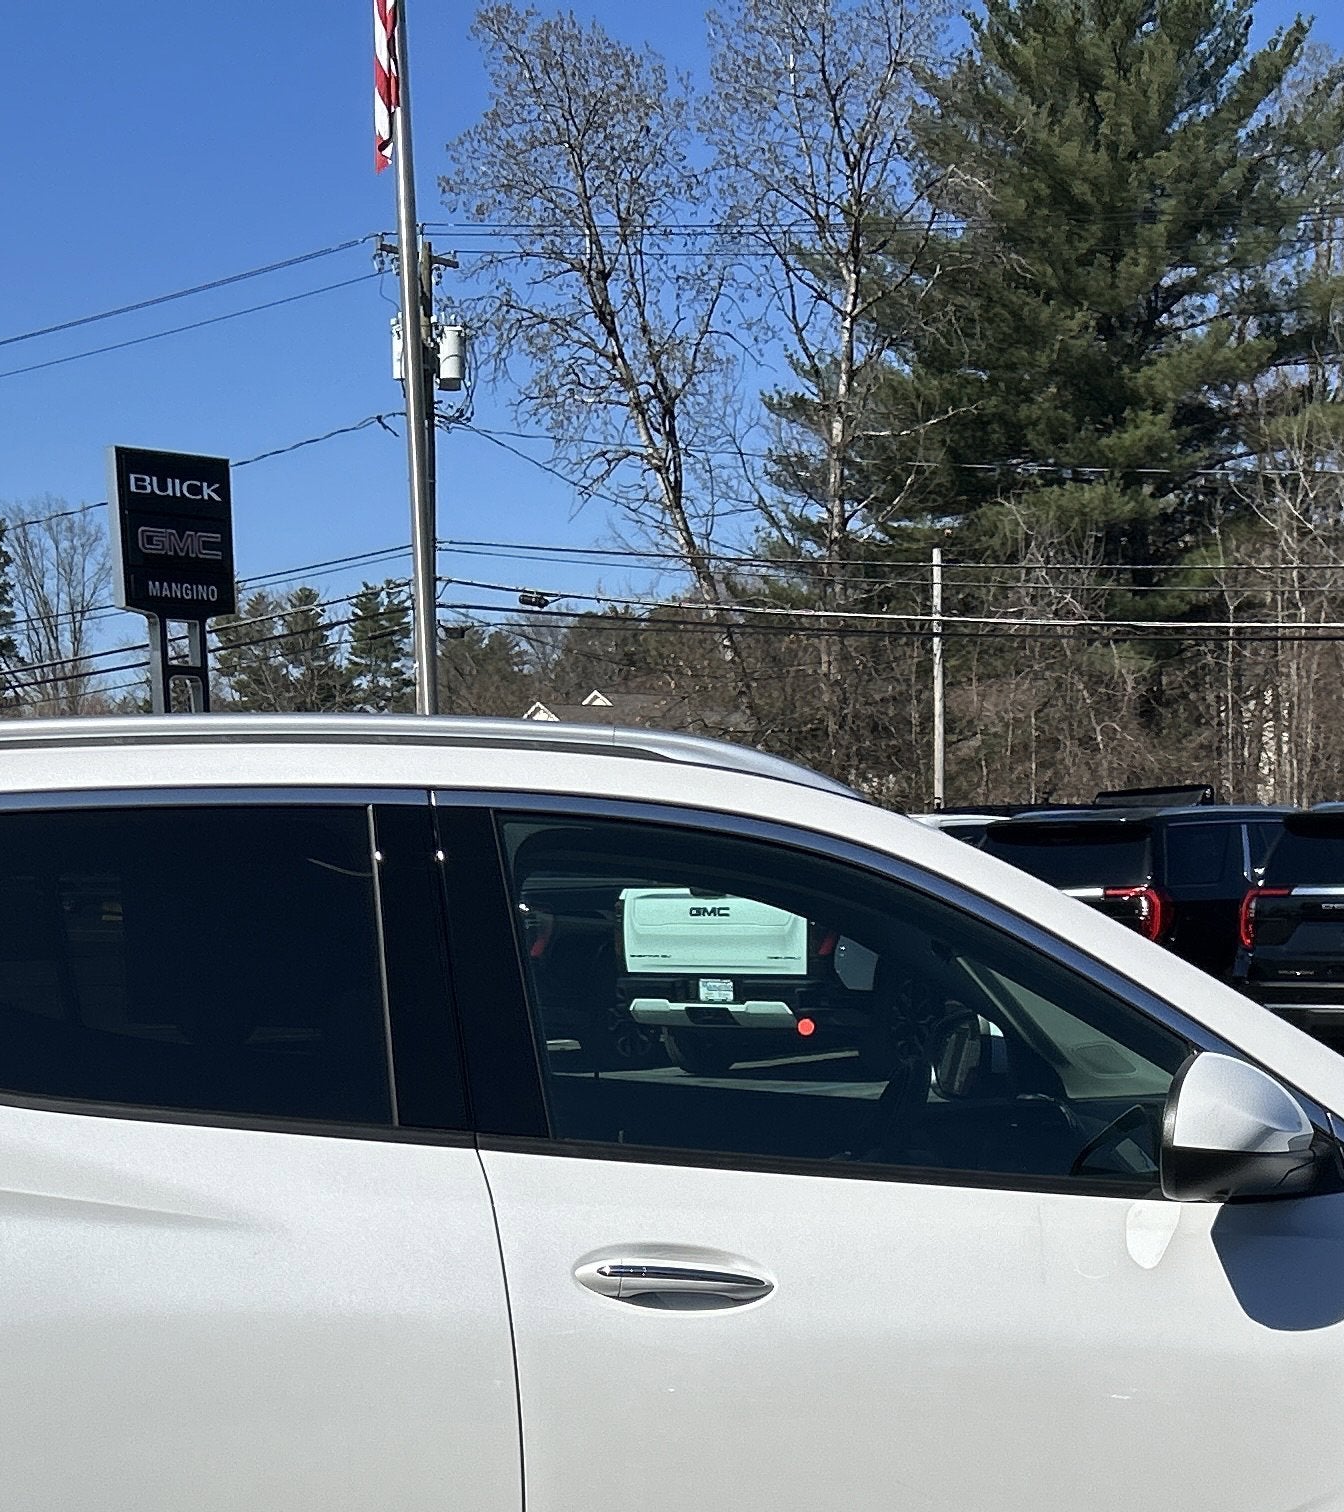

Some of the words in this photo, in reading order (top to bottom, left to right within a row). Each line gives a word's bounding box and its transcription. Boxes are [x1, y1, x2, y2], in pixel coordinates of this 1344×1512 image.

[129, 473, 222, 502] BUICK
[137, 525, 223, 560] GMC
[148, 580, 218, 602] MANGINO
[689, 906, 730, 917] GMC
